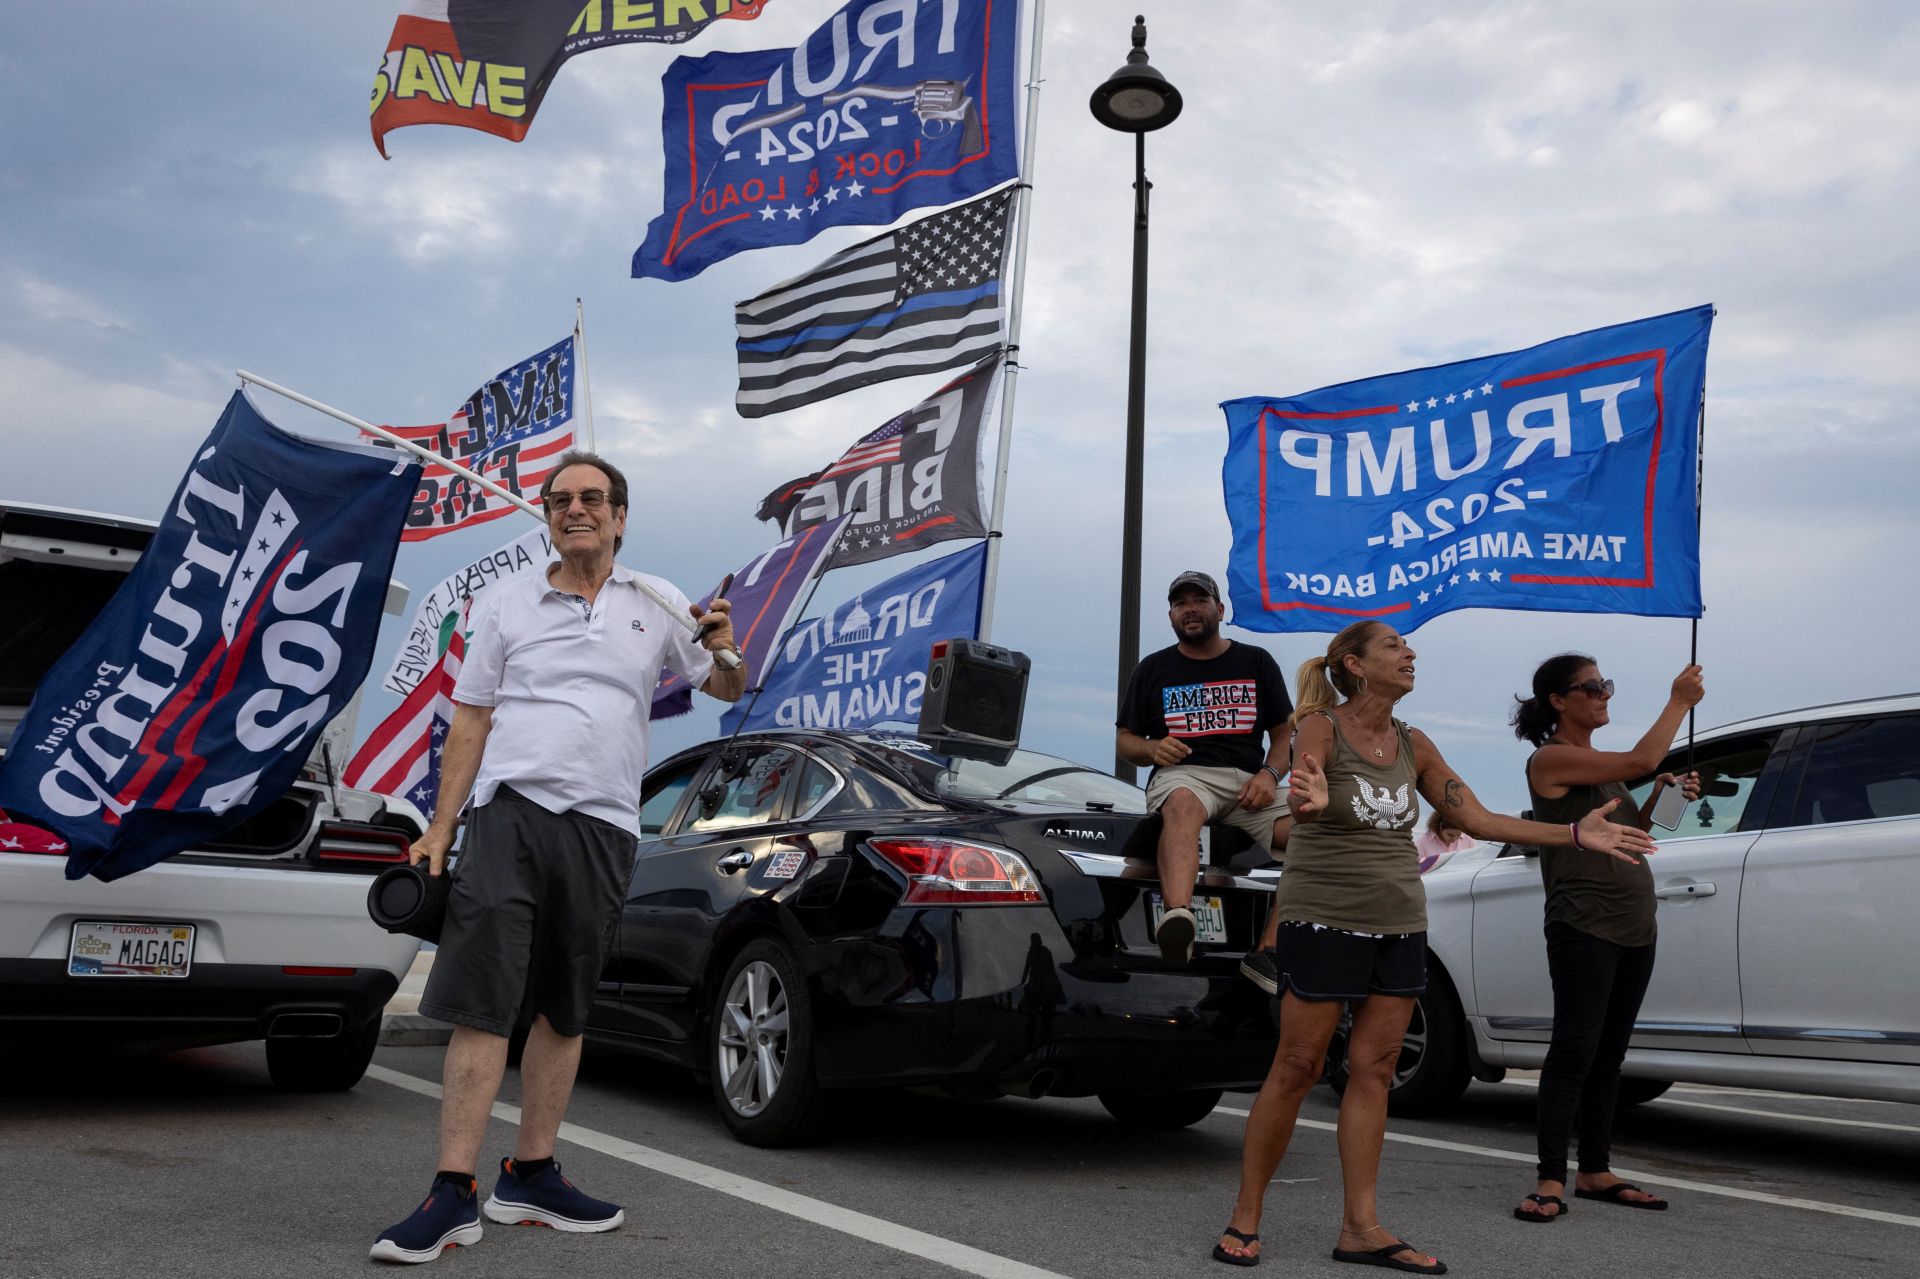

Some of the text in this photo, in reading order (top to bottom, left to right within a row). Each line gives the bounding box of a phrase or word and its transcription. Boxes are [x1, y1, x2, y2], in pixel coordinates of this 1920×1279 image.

[370, 46, 526, 118] SAVE
[1168, 684, 1253, 710] AMERICA
[1184, 708, 1239, 732] FIRST
[1042, 828, 1107, 841] ALTIMA
[112, 924, 159, 935] FLORIDA
[118, 938, 185, 966] MAGAG
